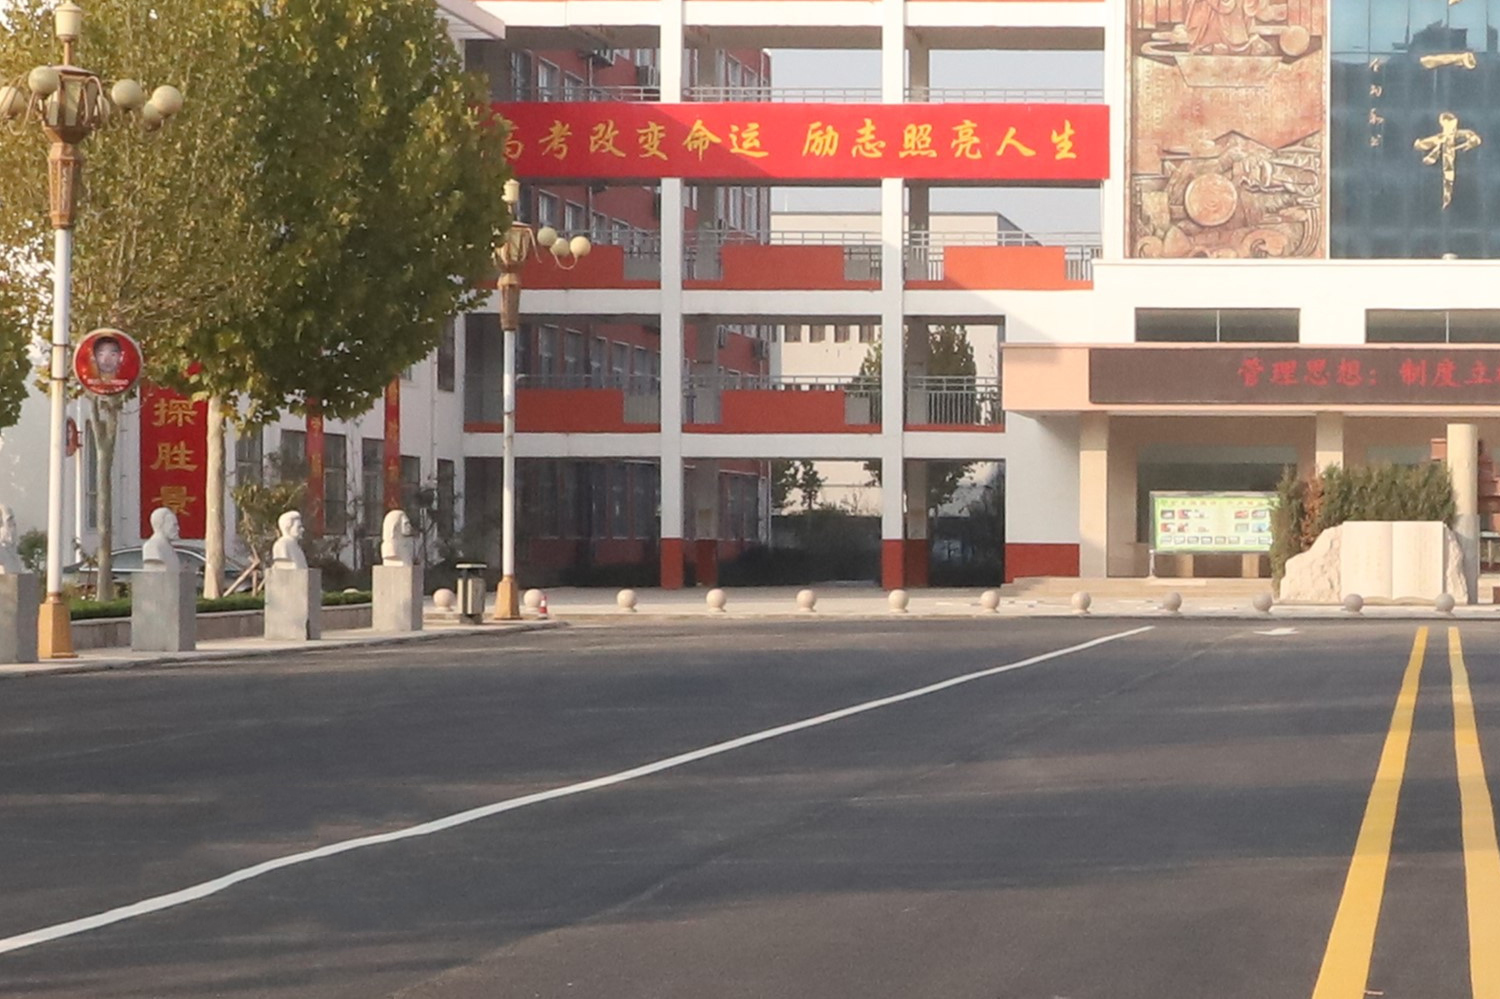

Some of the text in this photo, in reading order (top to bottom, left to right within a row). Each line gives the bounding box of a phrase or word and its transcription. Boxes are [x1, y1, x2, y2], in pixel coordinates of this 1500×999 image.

[802, 118, 1077, 160] 励志照亮人生
